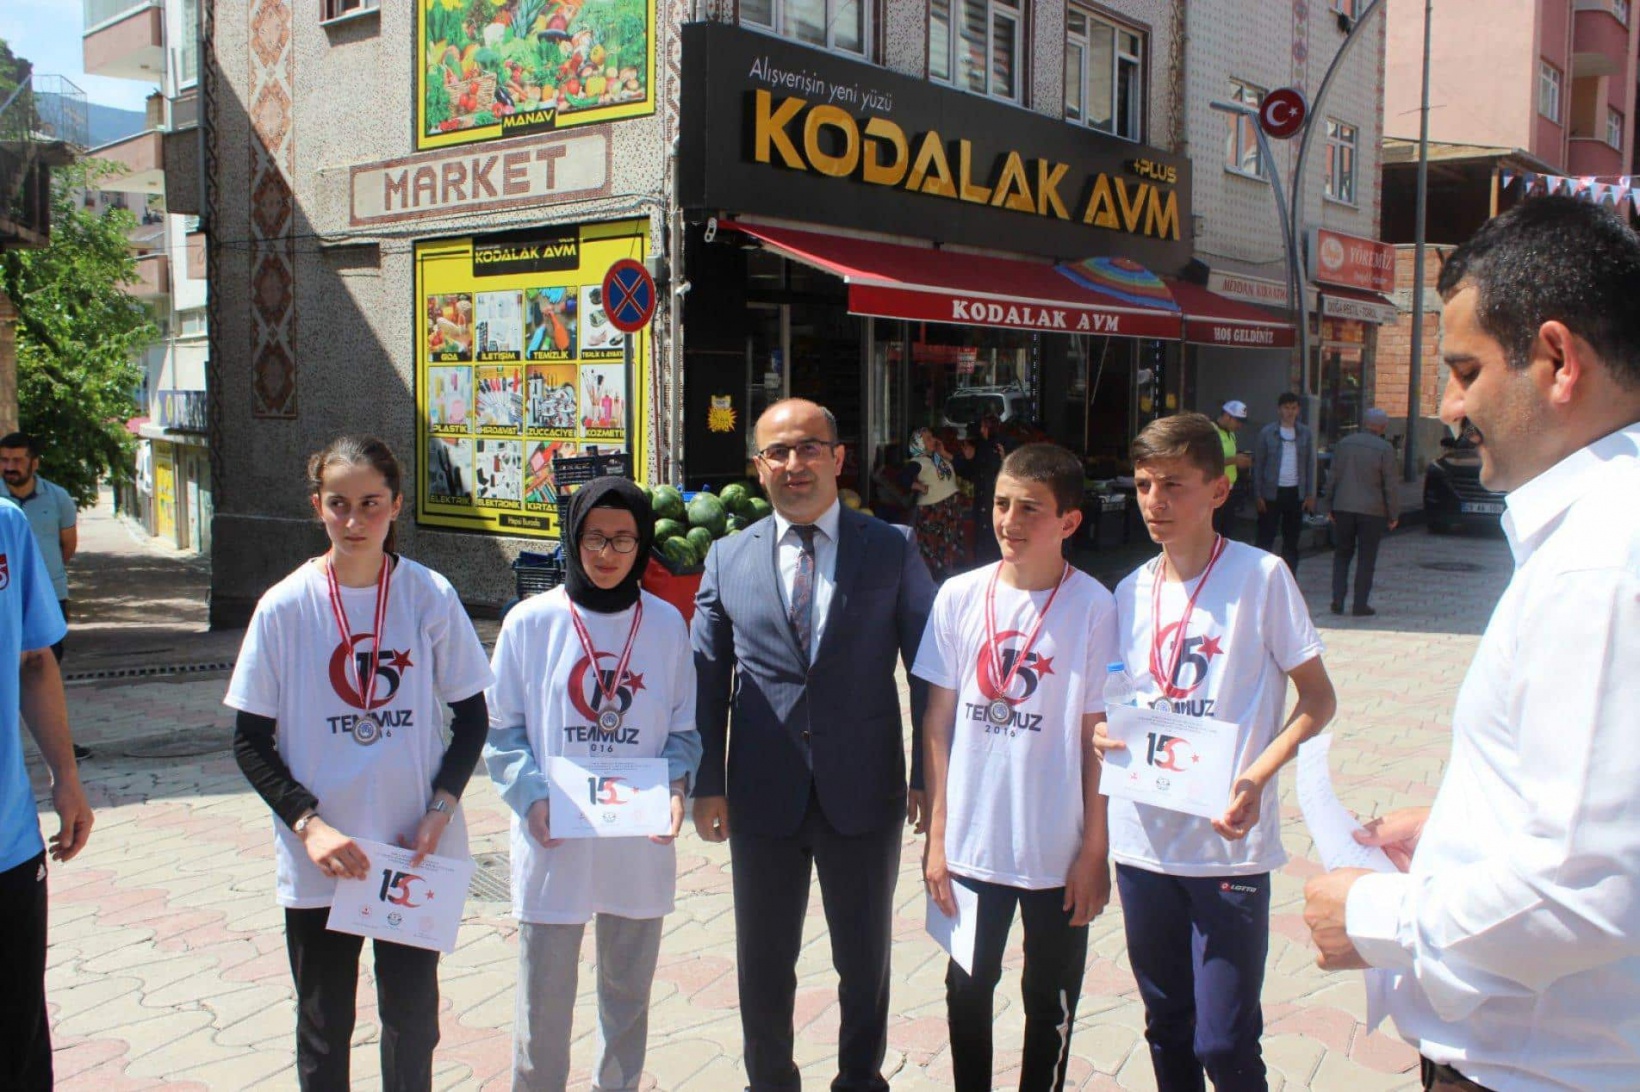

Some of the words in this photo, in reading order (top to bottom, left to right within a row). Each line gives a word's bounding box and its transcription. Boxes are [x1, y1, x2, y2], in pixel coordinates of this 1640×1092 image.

[749, 56, 825, 95] Alışverişin
[828, 83, 858, 103] yeni
[861, 89, 892, 111] yüzü
[503, 109, 554, 128] MANAV
[755, 89, 1071, 221] KODALAK
[1083, 172, 1181, 242] AVM
[384, 144, 567, 211] MARKET
[475, 246, 540, 264] KODALAK
[543, 243, 577, 259] AVM
[952, 299, 1067, 329] KODALAK
[1076, 312, 1120, 332] AVM
[1213, 327, 1232, 345] HOŞ
[1233, 326, 1275, 344] GELDİNİZ
[533, 349, 569, 360] TEMİZLİK
[481, 426, 518, 436] HIRDAVAT
[985, 724, 1016, 738] 2016
[590, 743, 614, 753] 016
